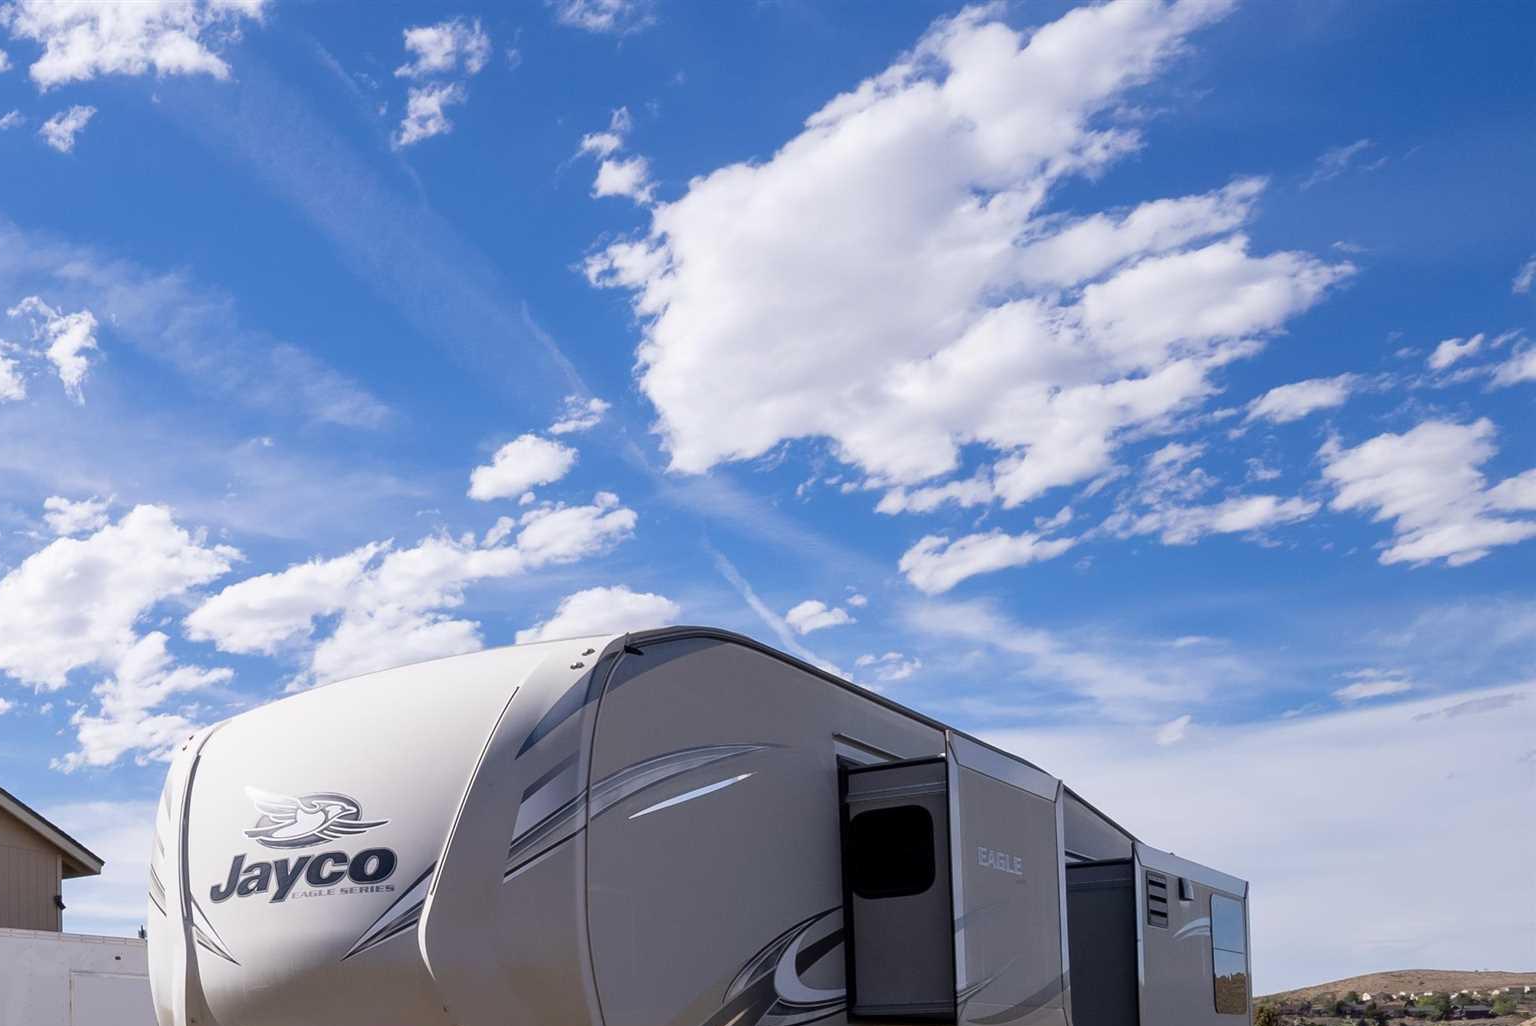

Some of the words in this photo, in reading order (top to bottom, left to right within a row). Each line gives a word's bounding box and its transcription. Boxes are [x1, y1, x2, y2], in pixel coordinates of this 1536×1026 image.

[209, 847, 398, 904] Jayco
[975, 846, 1025, 876] EAGLE
[291, 888, 336, 900] EAGLE
[340, 884, 396, 896] SERIES
